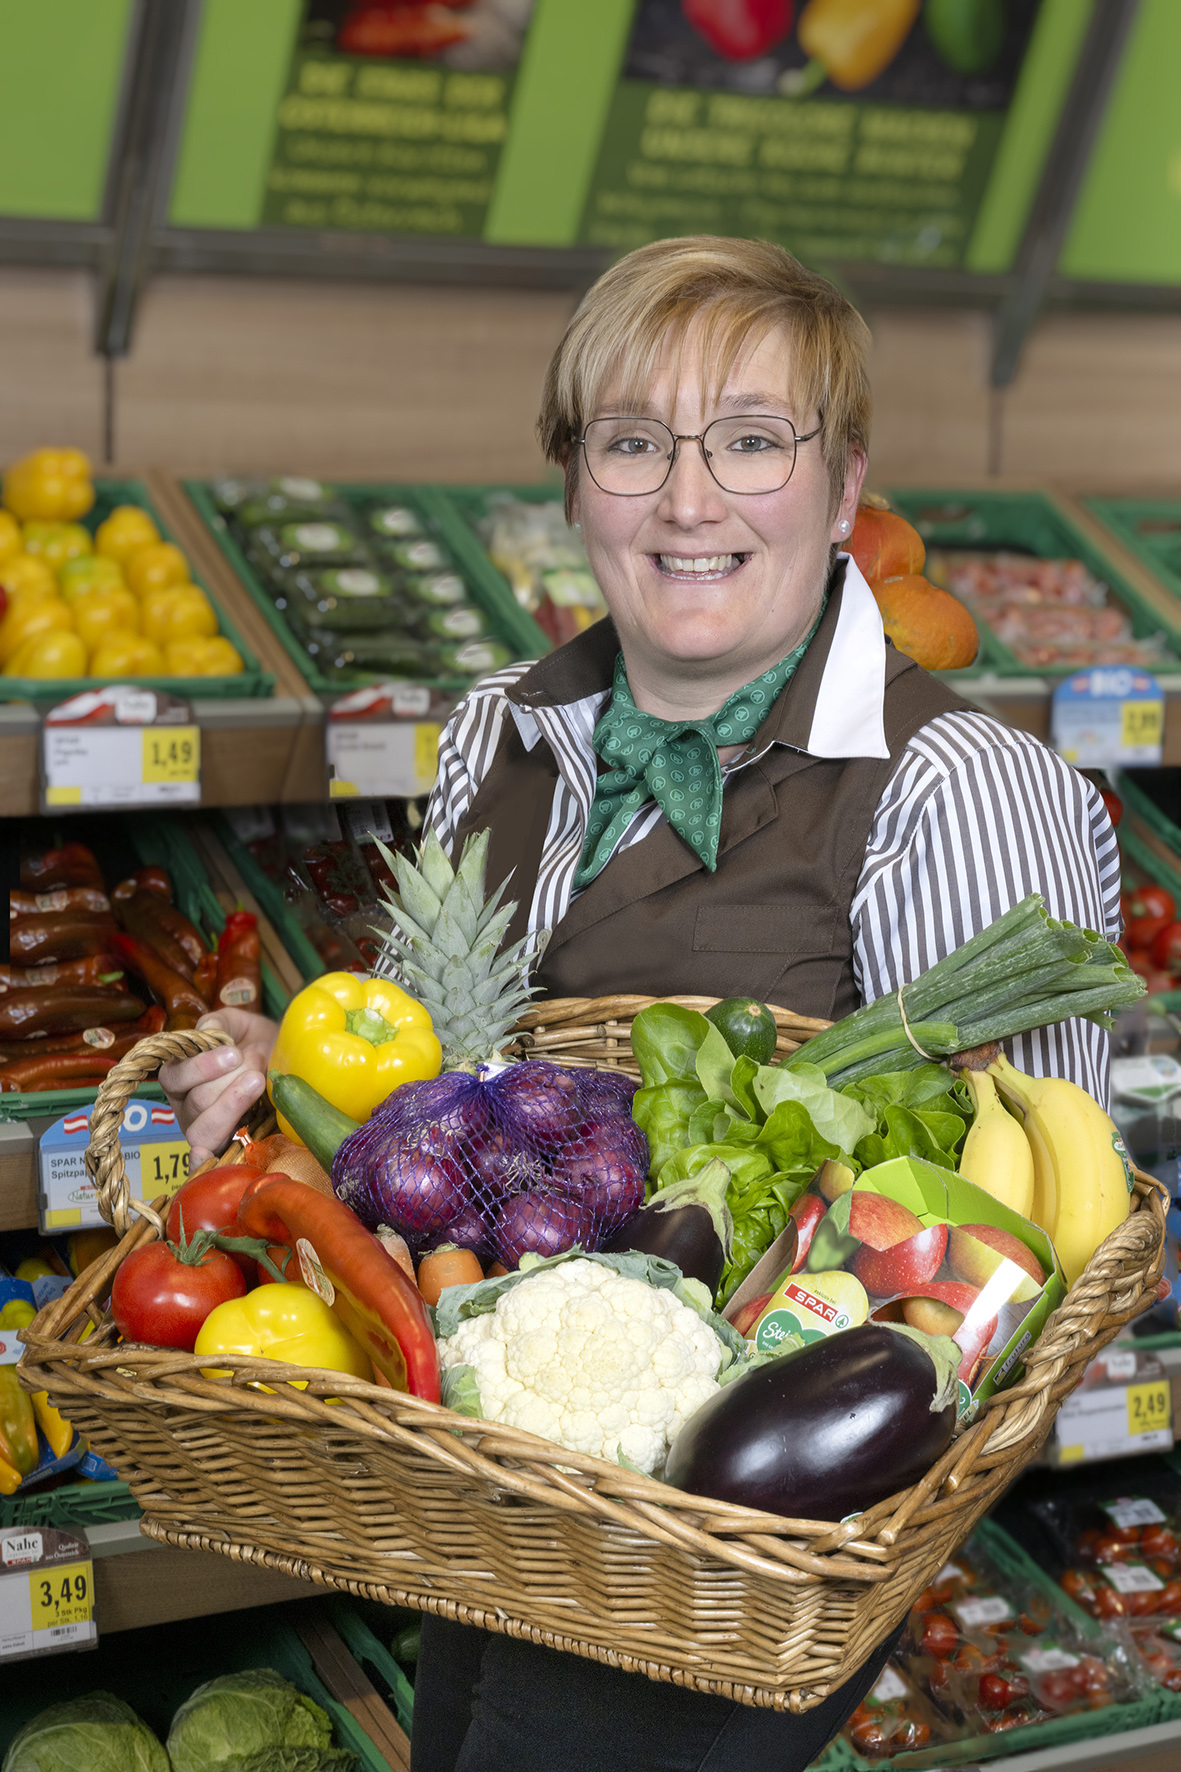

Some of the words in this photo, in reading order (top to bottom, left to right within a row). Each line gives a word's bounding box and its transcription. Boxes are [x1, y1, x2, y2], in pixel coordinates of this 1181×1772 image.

[152, 740, 192, 771] 1,49
[51, 1157, 77, 1168] SPAR
[124, 1150, 141, 1161] BIO
[153, 1152, 190, 1184] 1,79
[794, 1290, 837, 1321] SPAR
[1133, 1392, 1167, 1421] 2,49
[7, 1537, 39, 1552] Nahe
[40, 1574, 87, 1611] 3,49
[61, 1609, 72, 1617] Stk
[74, 1606, 88, 1615] Pkg
[47, 1620, 58, 1629] per
